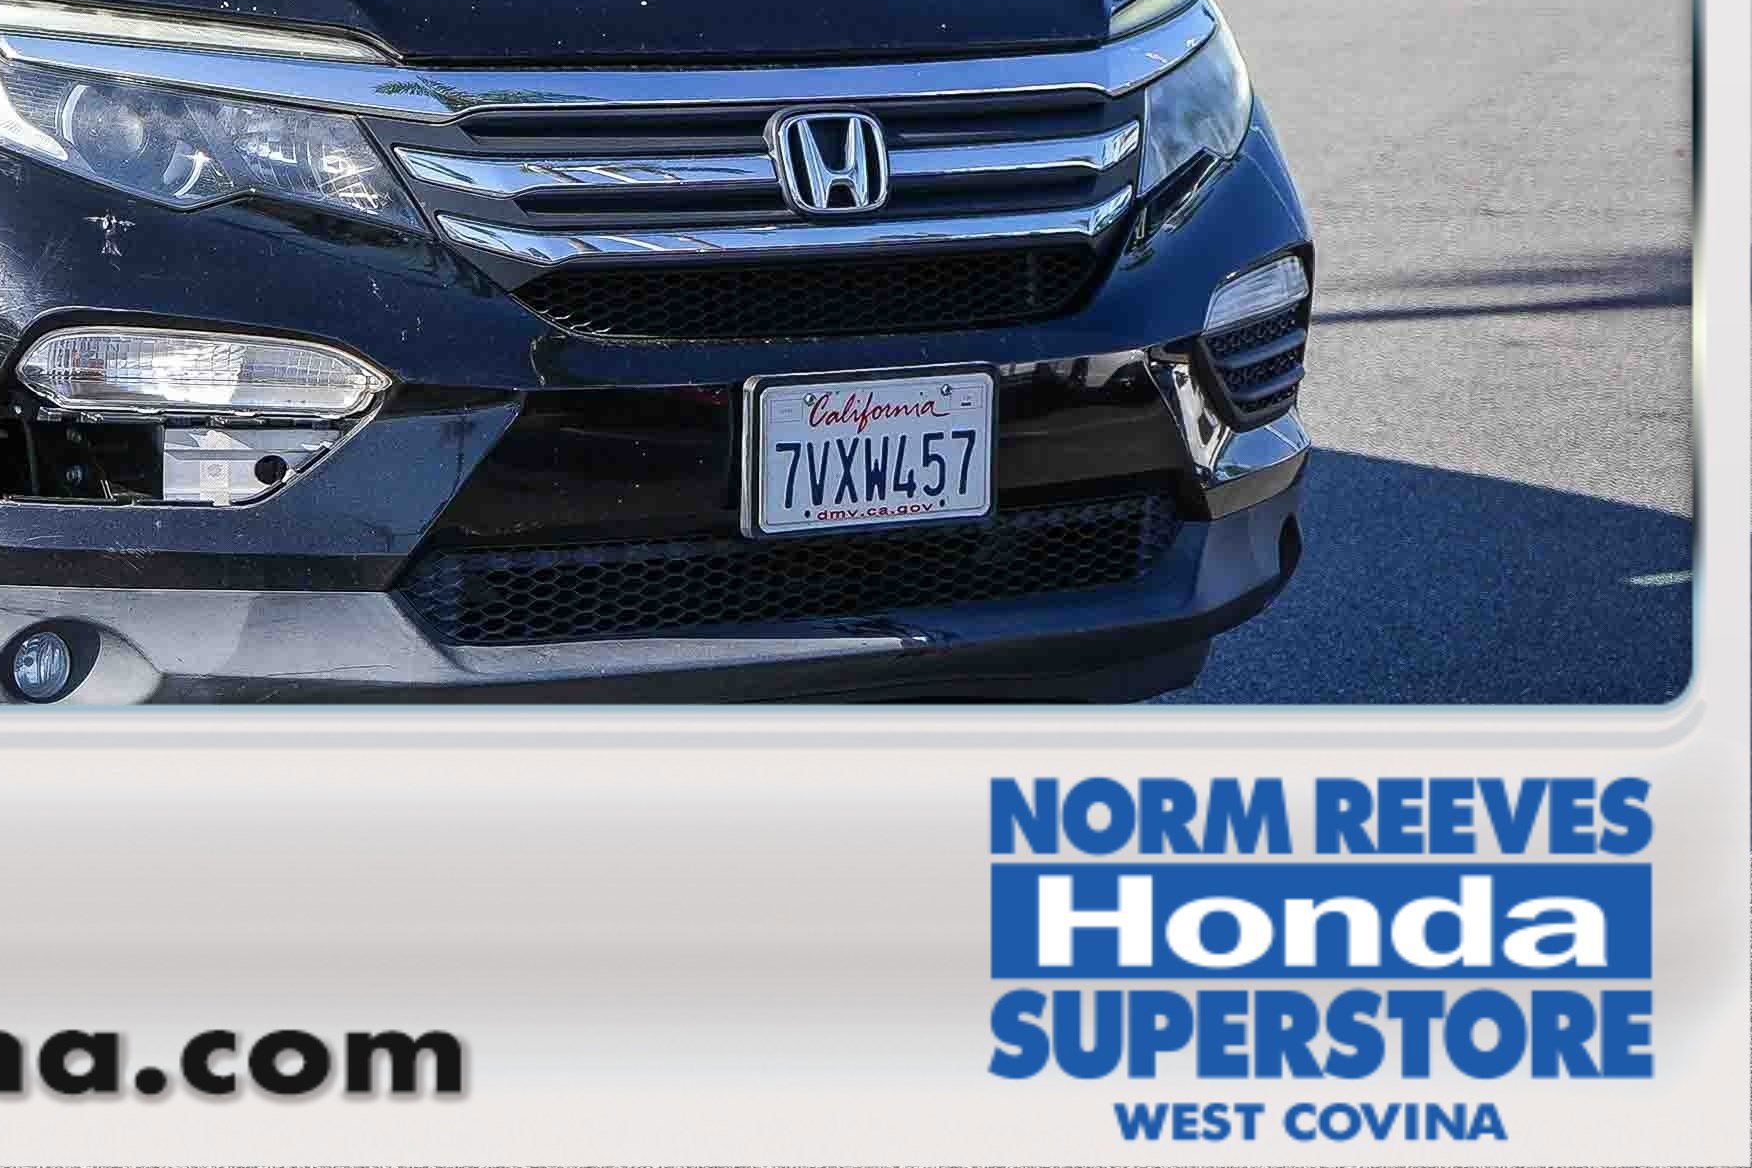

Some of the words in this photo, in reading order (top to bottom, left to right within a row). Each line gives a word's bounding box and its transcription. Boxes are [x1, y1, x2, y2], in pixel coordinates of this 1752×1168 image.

[808, 390, 950, 433] California
[775, 429, 977, 509] 7VXW457
[816, 502, 934, 521] dmv.ca.gov
